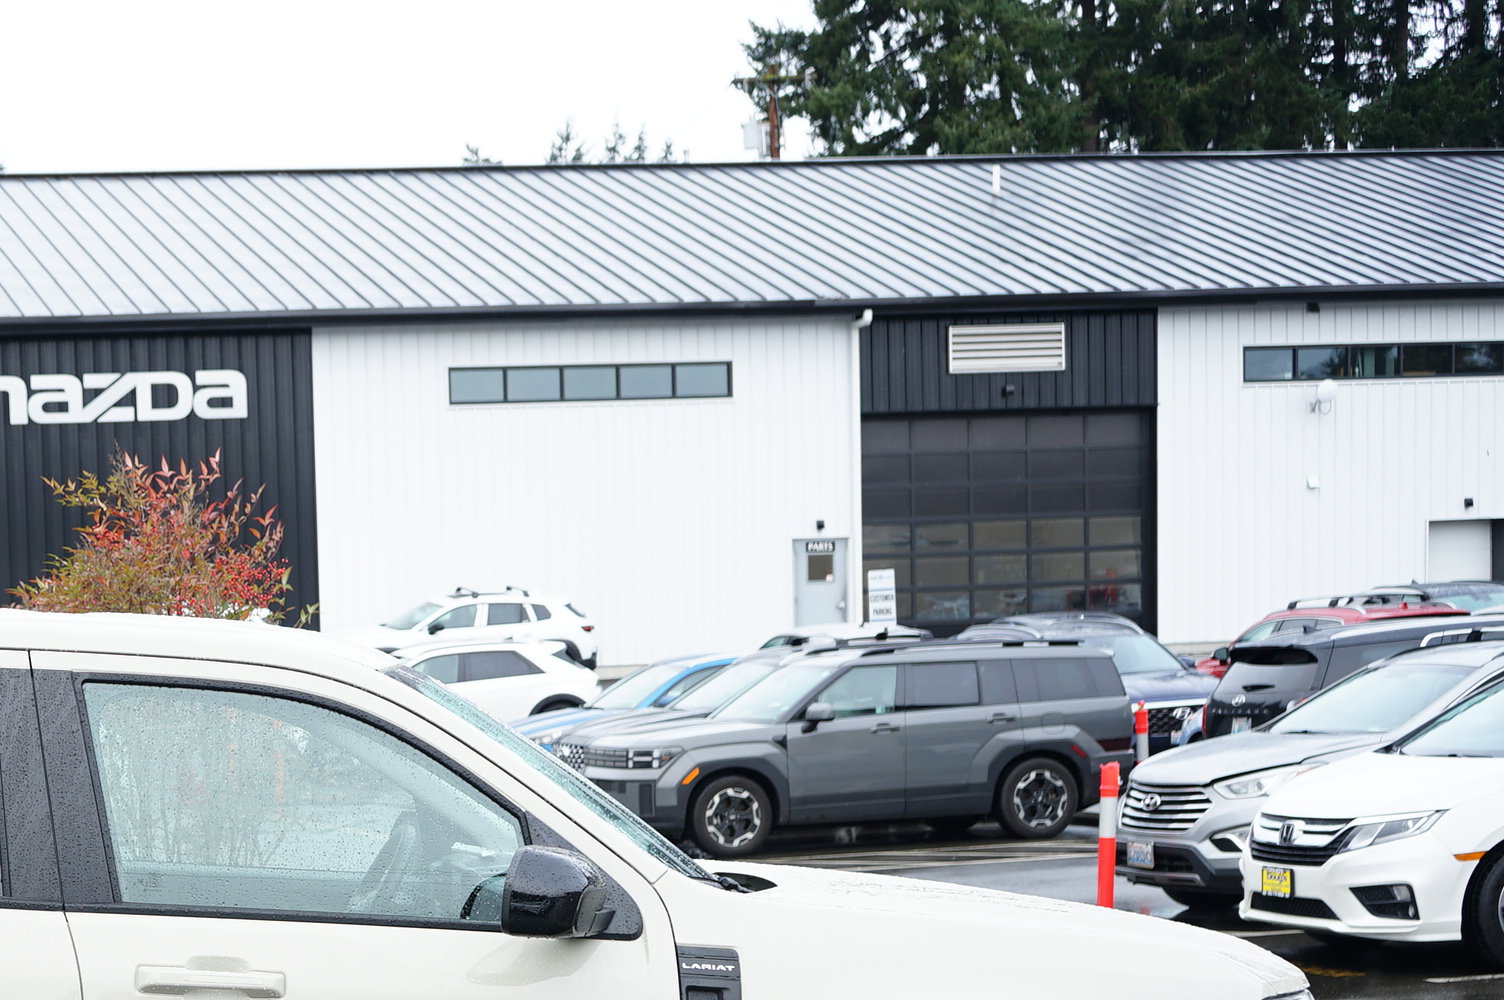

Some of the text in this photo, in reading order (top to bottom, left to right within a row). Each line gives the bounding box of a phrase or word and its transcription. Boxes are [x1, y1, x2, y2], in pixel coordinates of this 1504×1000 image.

[808, 541, 834, 552] PARTS
[873, 607, 892, 616] PARKING
[681, 962, 735, 971] LARIAT
